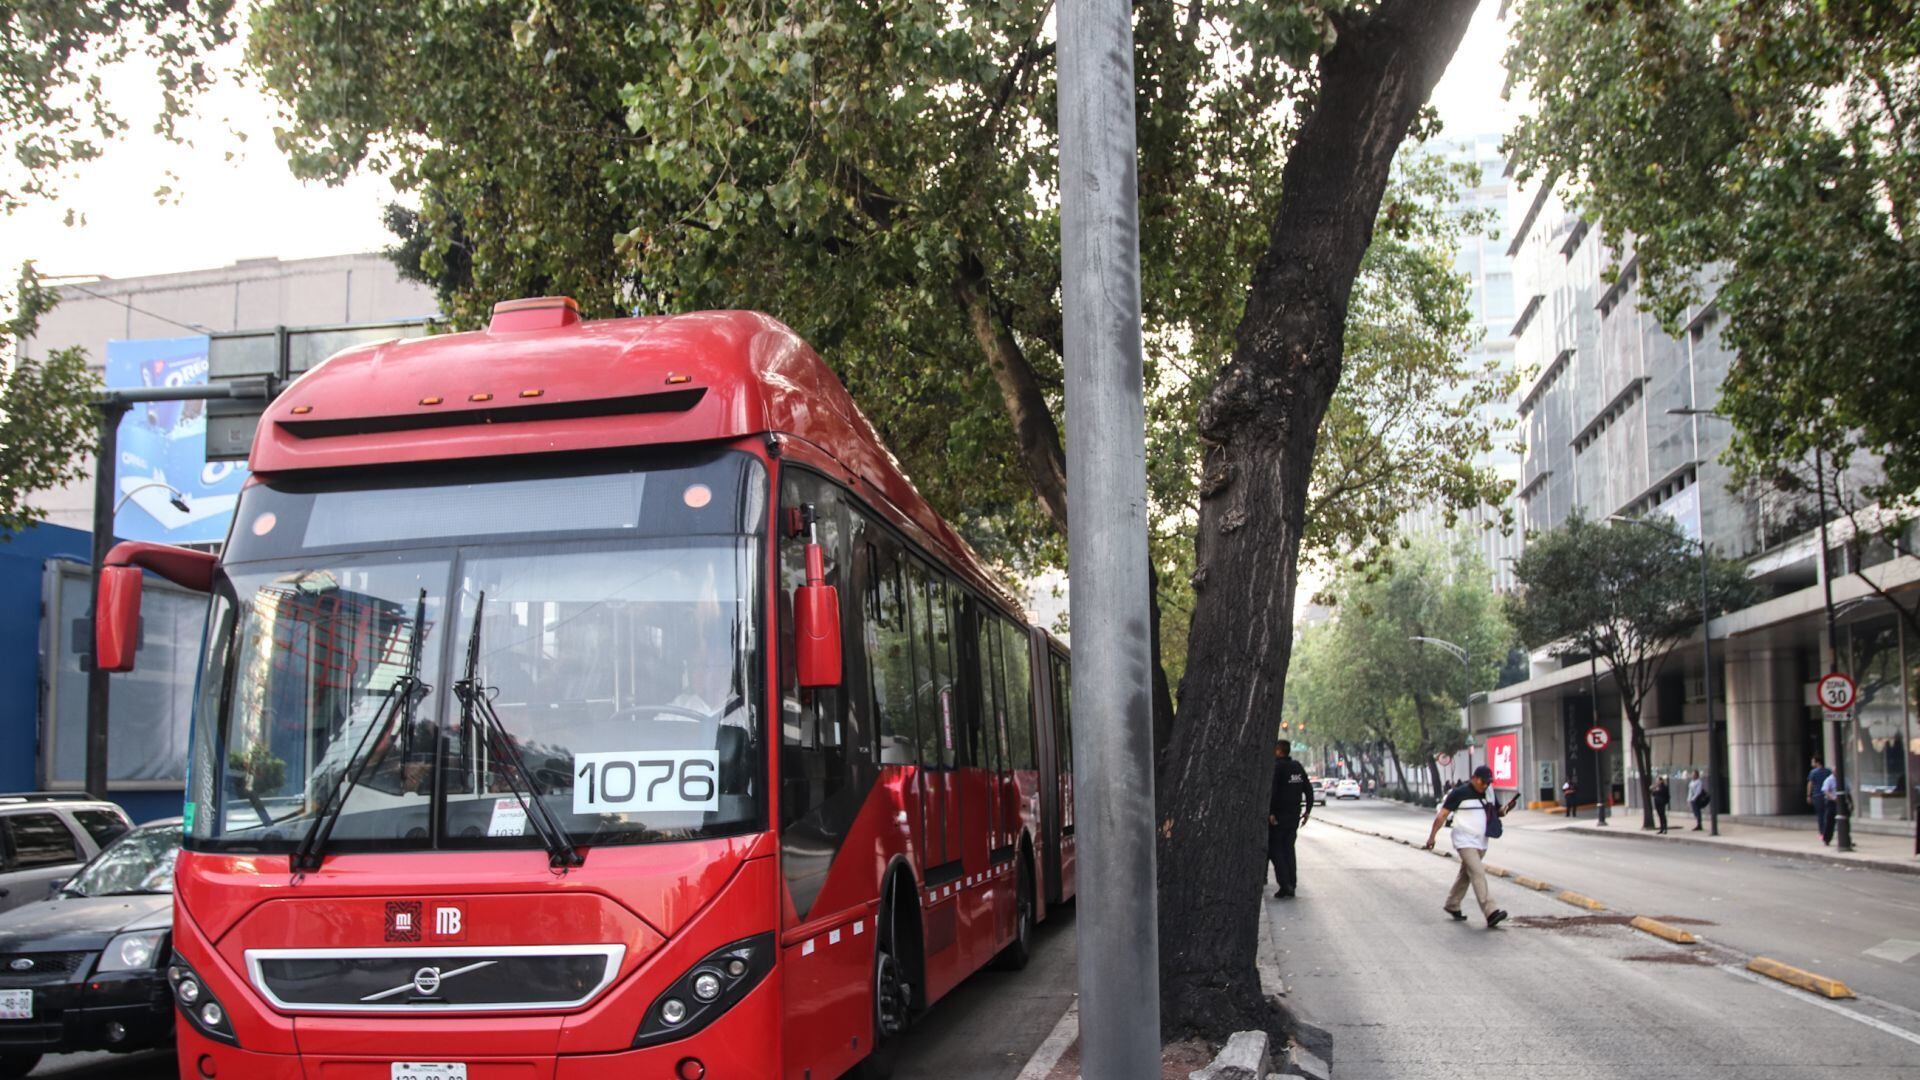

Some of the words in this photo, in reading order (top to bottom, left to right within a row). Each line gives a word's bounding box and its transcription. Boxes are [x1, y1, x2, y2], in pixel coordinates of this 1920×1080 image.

[1828, 690, 1847, 705] 30
[1592, 730, 1605, 745] E
[578, 759, 715, 804] 1076
[436, 907, 462, 934] MB
